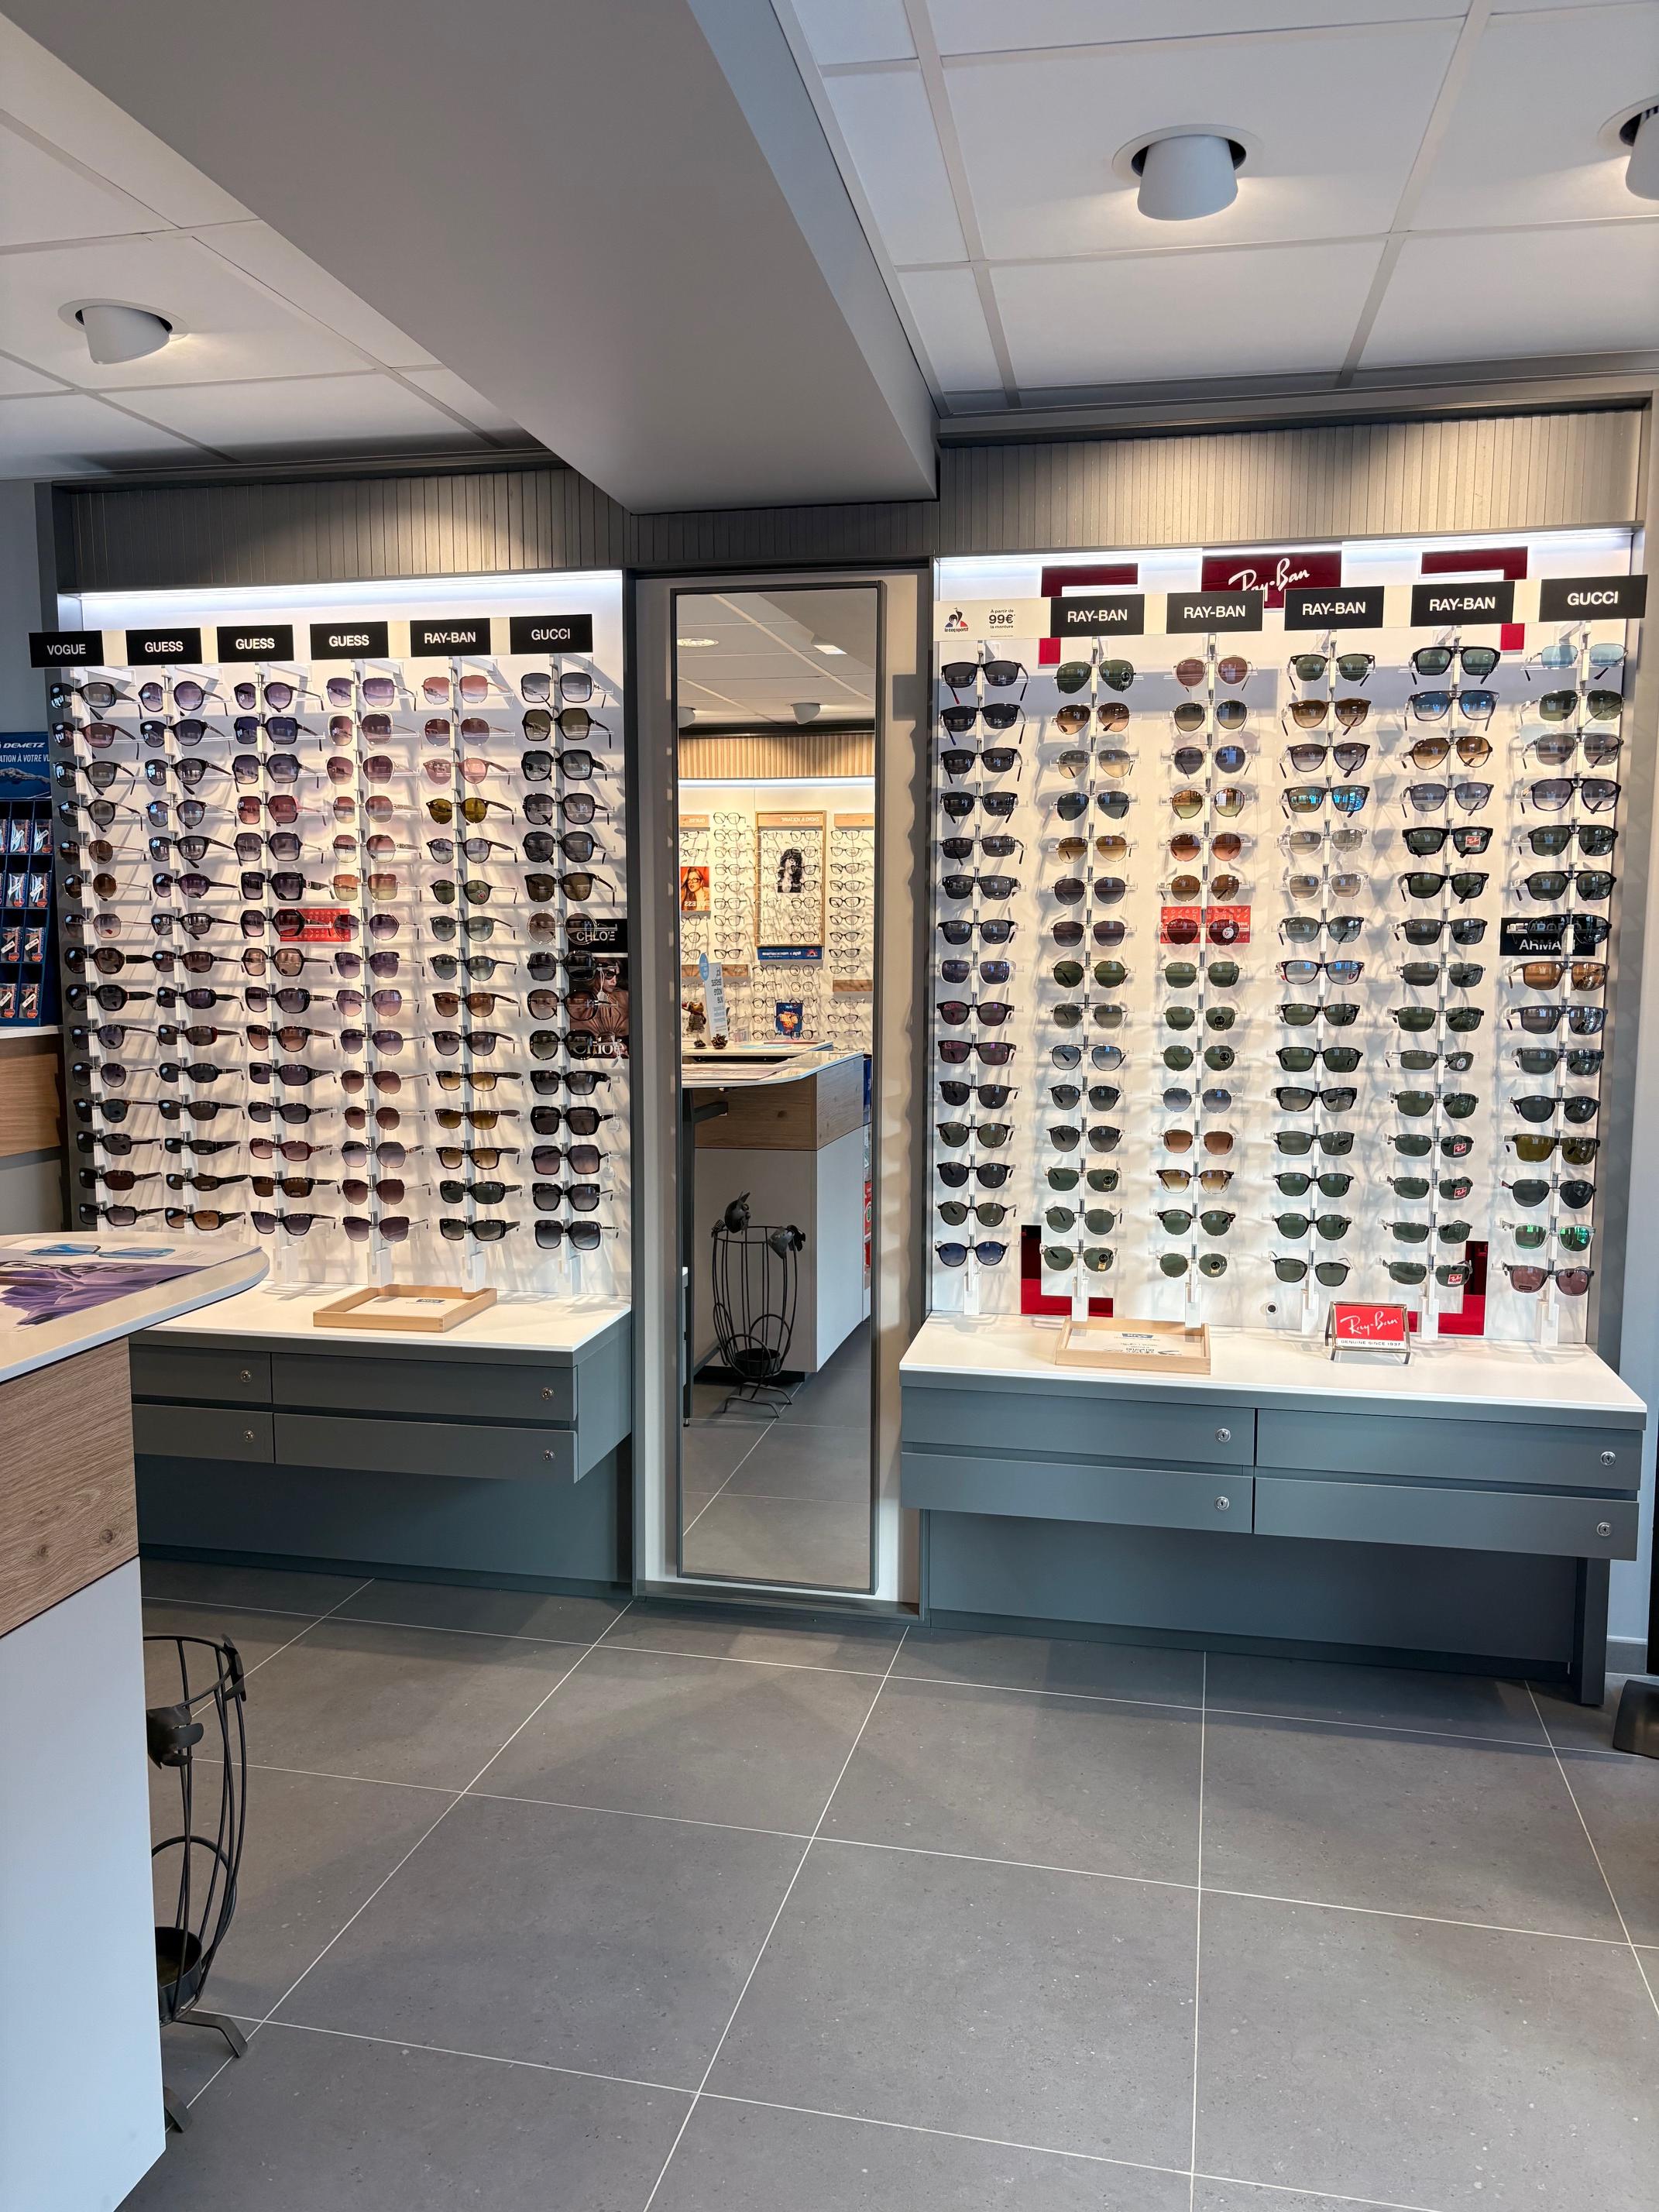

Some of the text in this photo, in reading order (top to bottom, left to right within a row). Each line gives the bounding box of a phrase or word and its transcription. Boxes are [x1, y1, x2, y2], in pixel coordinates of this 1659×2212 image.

[1430, 597, 1495, 611] RAY-BAN
[1568, 591, 1618, 606] GUCCI
[1184, 605, 1245, 618] RAY-BAN
[1303, 602, 1365, 615] RAY-BAN
[1068, 609, 1127, 622] RAY-BAN
[424, 632, 476, 644] RAY-BAN
[531, 629, 570, 640] GUCCI
[145, 641, 183, 652] GUESS
[236, 638, 275, 649] GUESS
[329, 635, 369, 647] GUESS
[47, 644, 85, 654] VOGUE
[17, 753, 22, 762] À
[23, 754, 42, 762] VOTRE
[1340, 1310, 1399, 1337] Ray-Ban
